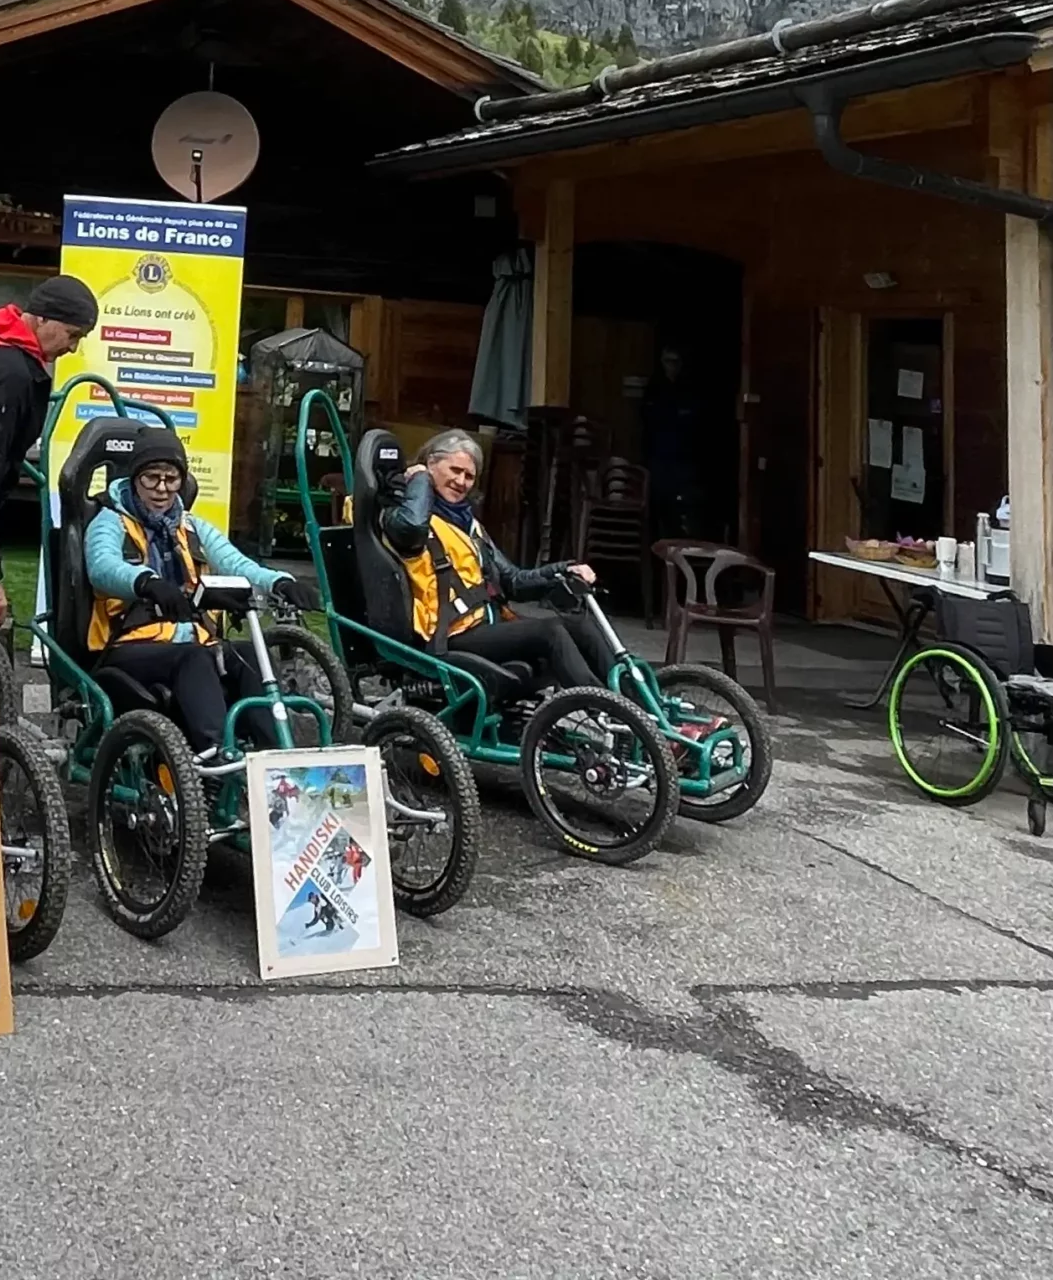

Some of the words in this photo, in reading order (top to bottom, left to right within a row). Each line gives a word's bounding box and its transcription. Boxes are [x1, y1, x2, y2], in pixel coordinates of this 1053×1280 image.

[188, 219, 204, 228] plus
[77, 222, 130, 240] Lions
[135, 226, 160, 242] de
[164, 228, 233, 248] France
[104, 304, 122, 316] Les
[124, 305, 152, 318] Lions
[154, 310, 172, 320] ont
[120, 351, 144, 360] Centre
[284, 812, 340, 892] HANDISKI
[309, 866, 332, 892] CLUB
[329, 888, 360, 925] LOISIRS
